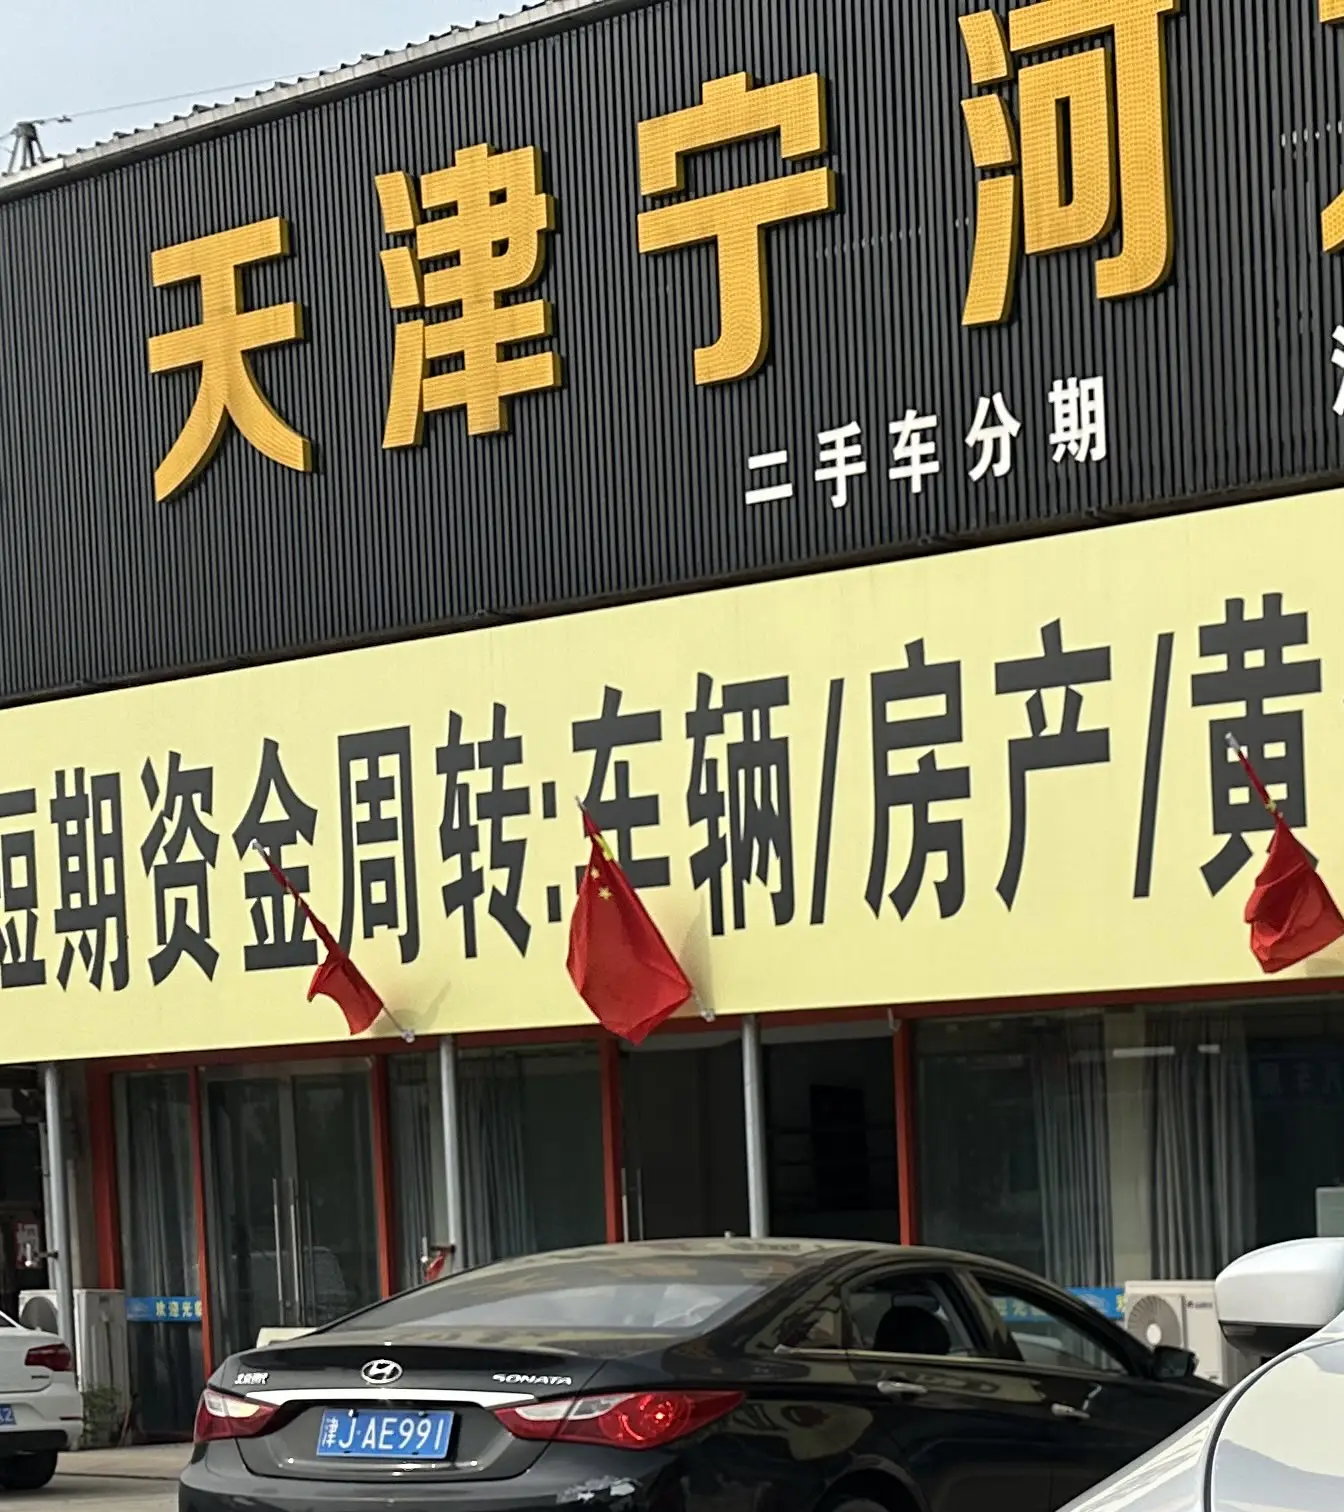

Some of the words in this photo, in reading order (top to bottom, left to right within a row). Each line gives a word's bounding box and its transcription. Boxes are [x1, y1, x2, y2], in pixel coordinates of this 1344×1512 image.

[744, 375, 1107, 509] 二手车分期
[492, 1373, 572, 1385] SONATA
